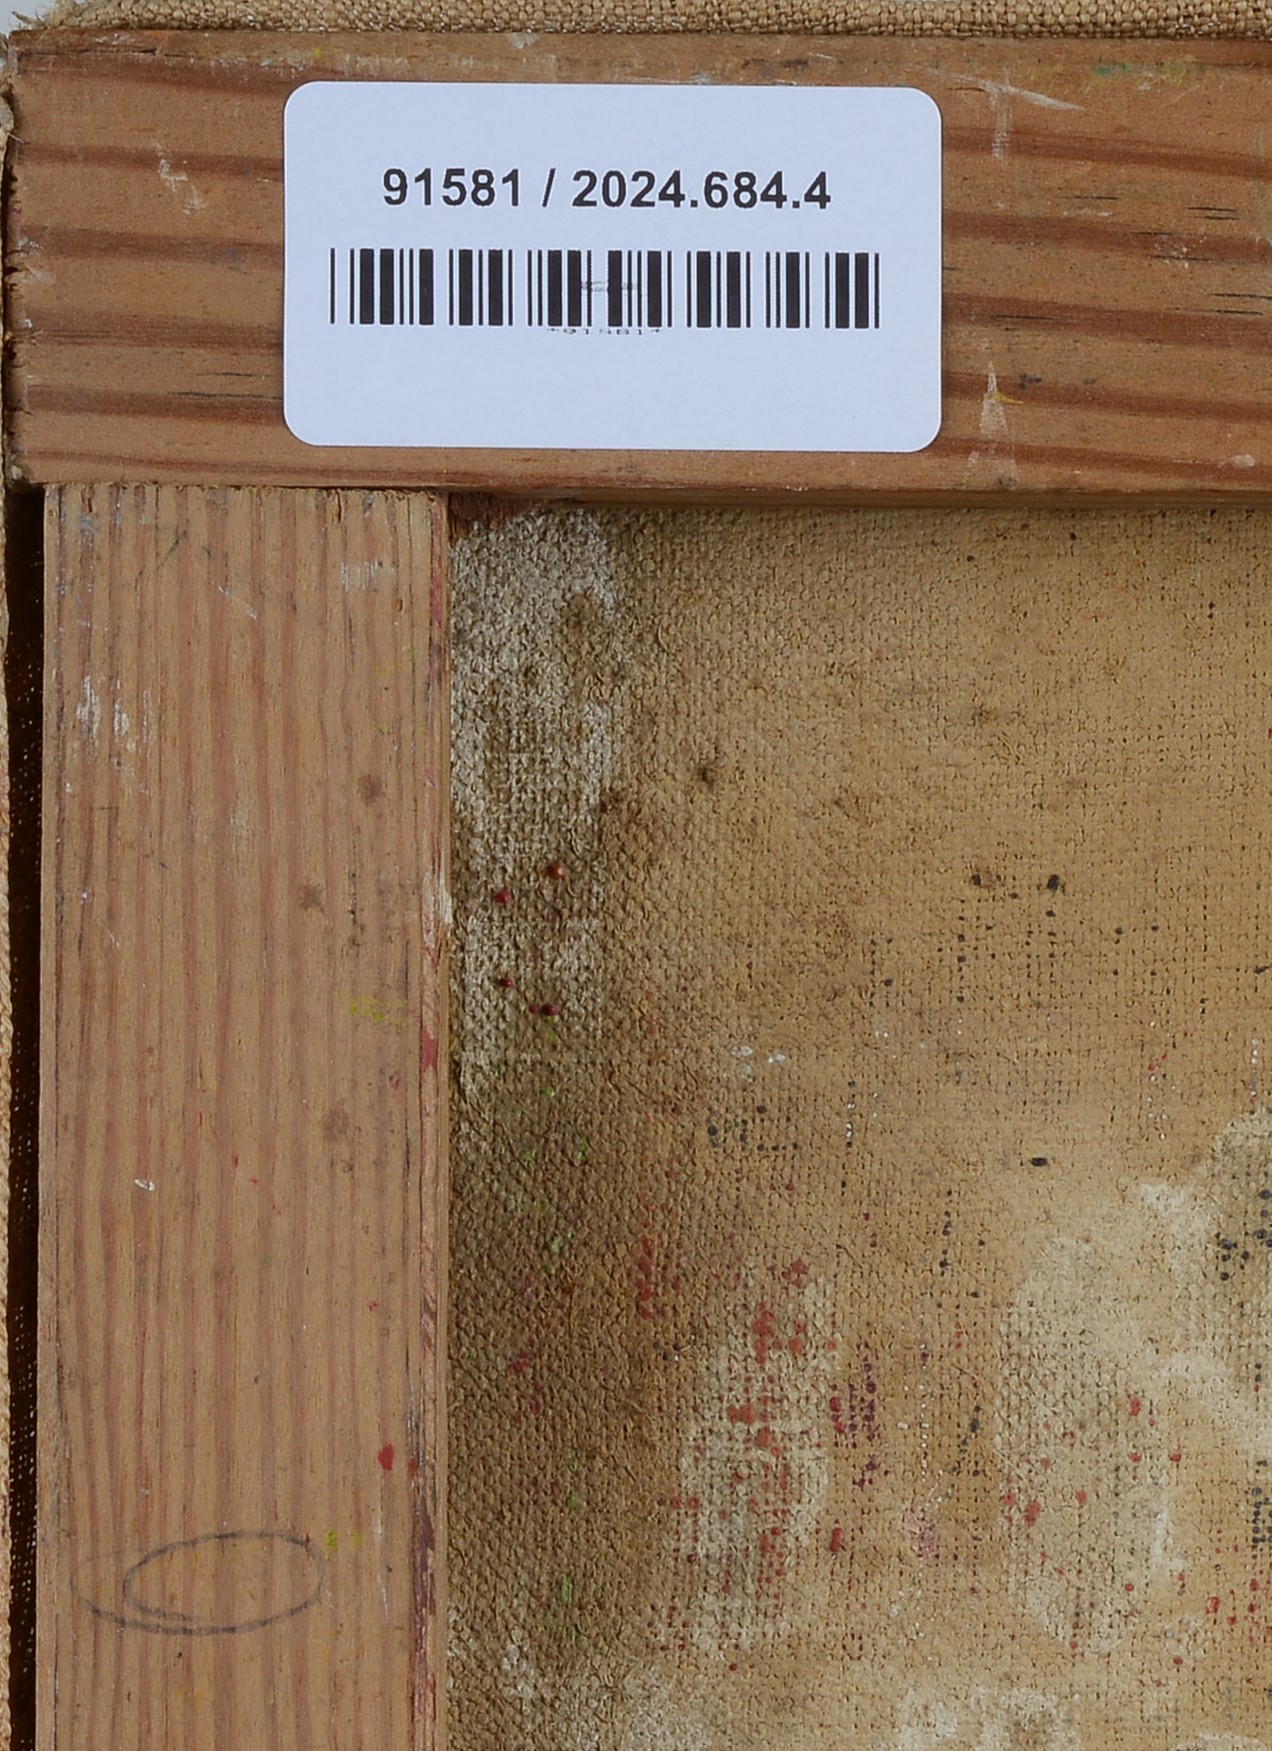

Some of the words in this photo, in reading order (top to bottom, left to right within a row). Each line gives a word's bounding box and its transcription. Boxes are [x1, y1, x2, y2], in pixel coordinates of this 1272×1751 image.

[383, 167, 520, 208] 91581
[541, 167, 557, 208] /
[571, 169, 832, 210] 2024.684.4
